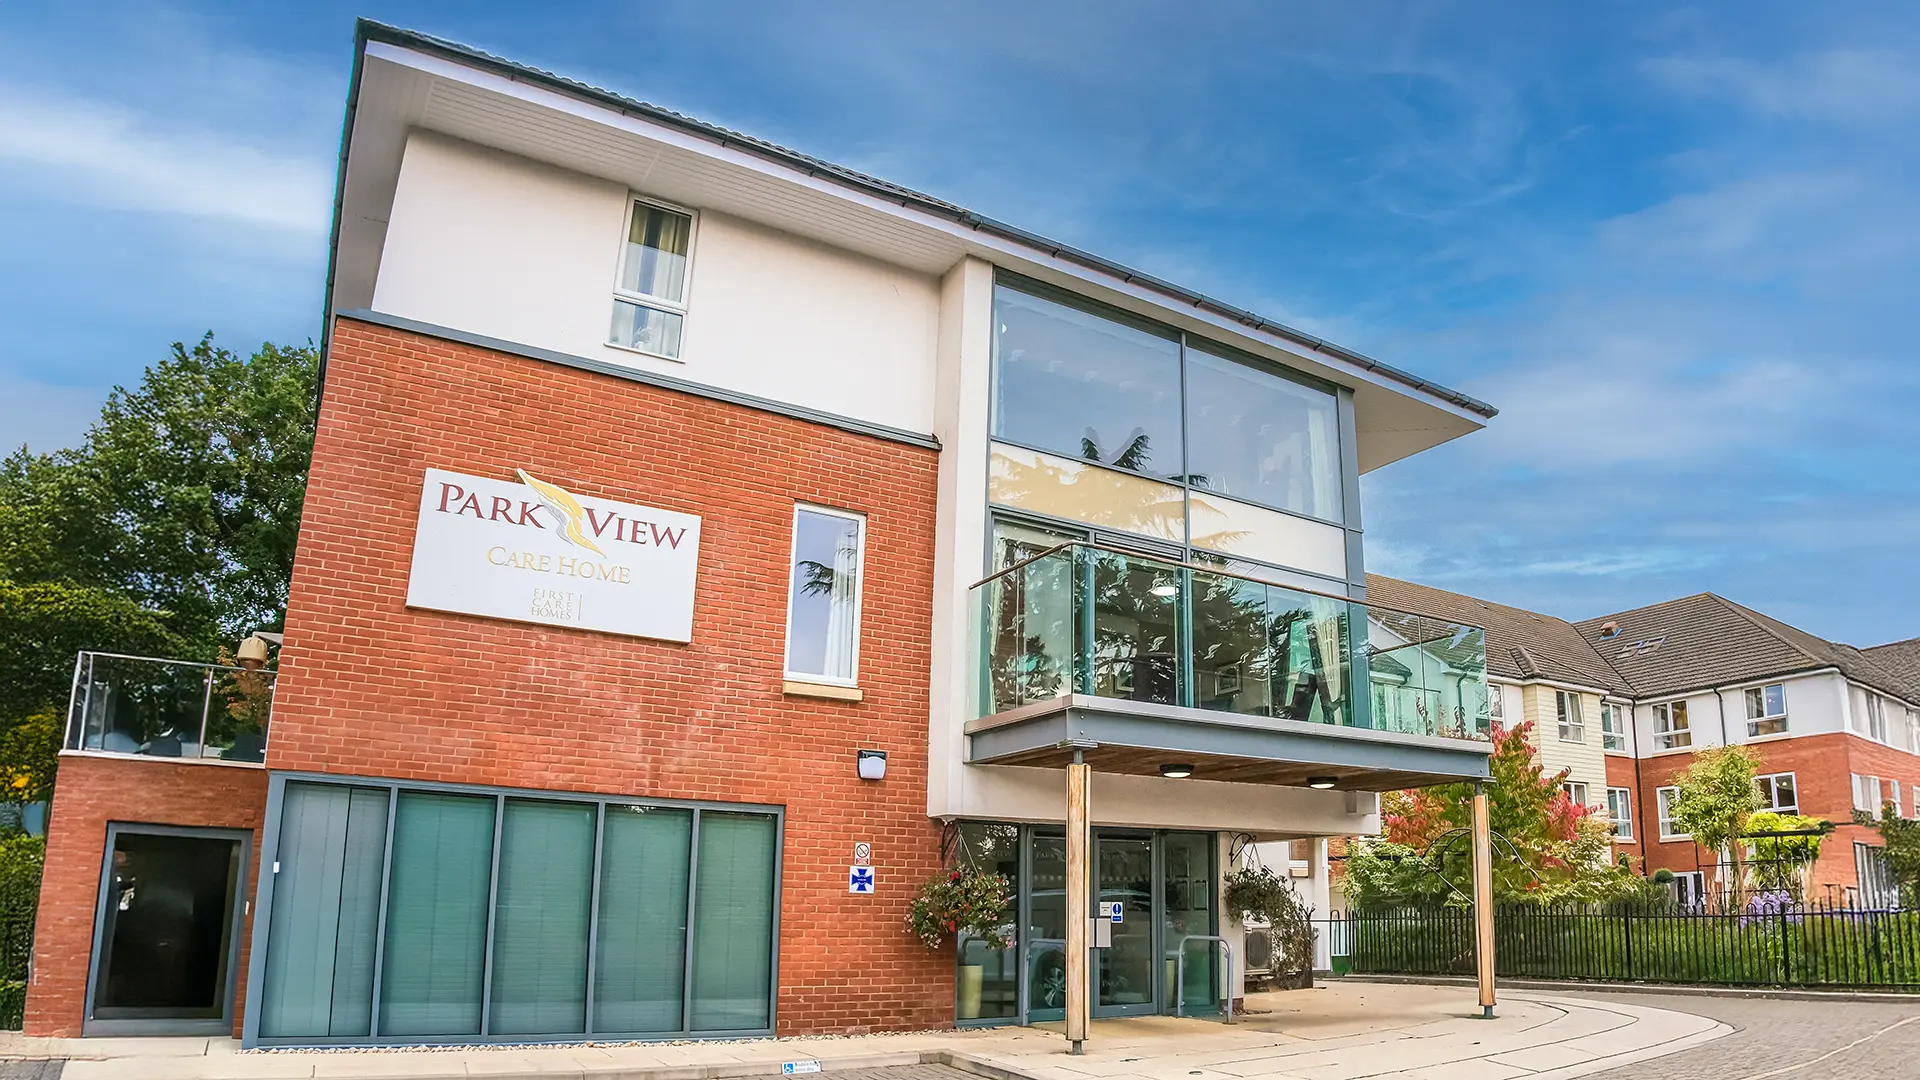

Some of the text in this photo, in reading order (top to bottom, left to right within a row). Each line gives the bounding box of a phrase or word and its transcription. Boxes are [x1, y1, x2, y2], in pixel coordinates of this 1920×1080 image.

[436, 482, 687, 550] PARK VIEW
[487, 546, 631, 584] CARE HOME
[533, 588, 574, 601] FIRST
[532, 597, 572, 611] CARE
[531, 606, 571, 620] HOMES
